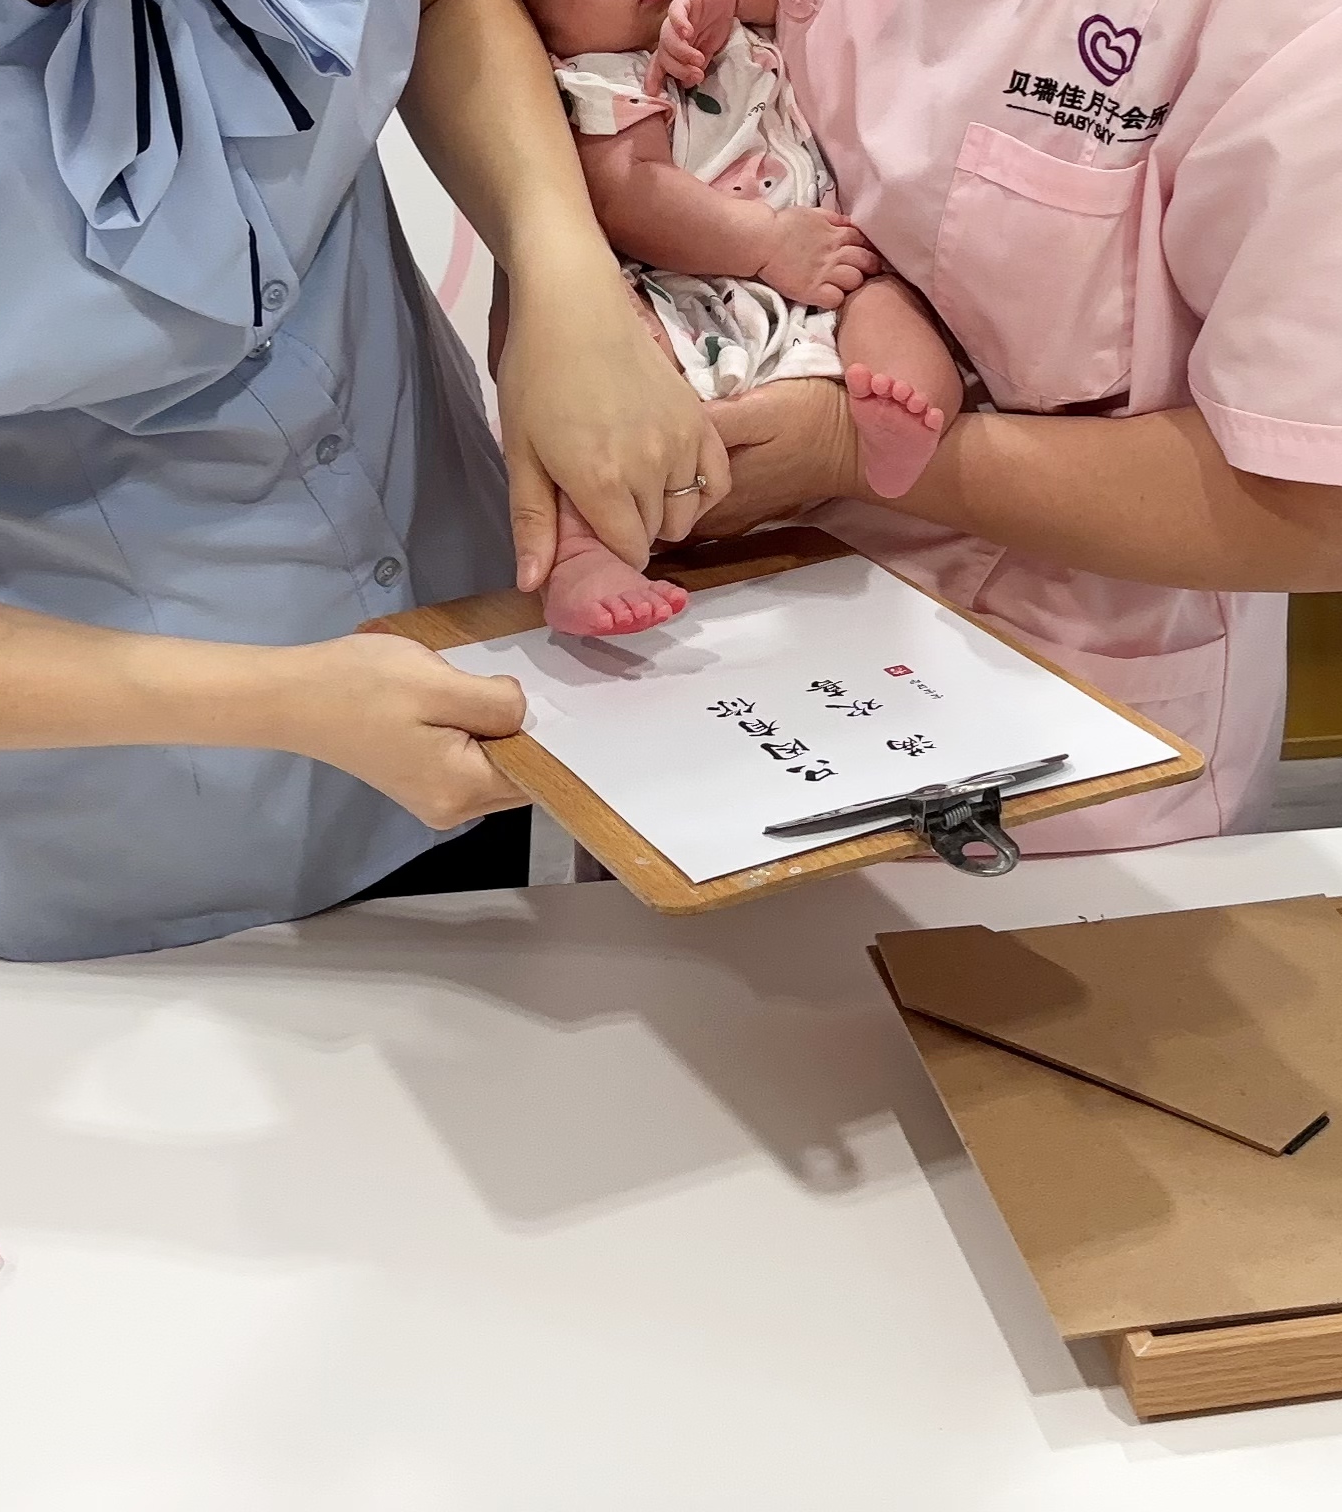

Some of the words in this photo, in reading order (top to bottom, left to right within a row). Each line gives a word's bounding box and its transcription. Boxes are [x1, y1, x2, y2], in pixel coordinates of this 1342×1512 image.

[1003, 69, 1170, 130] 贝瑞佳月子会所
[1054, 111, 1095, 133] BABY
[806, 680, 883, 716] 欢喜
[706, 697, 838, 781] 只因有你
[886, 734, 937, 756] 满
